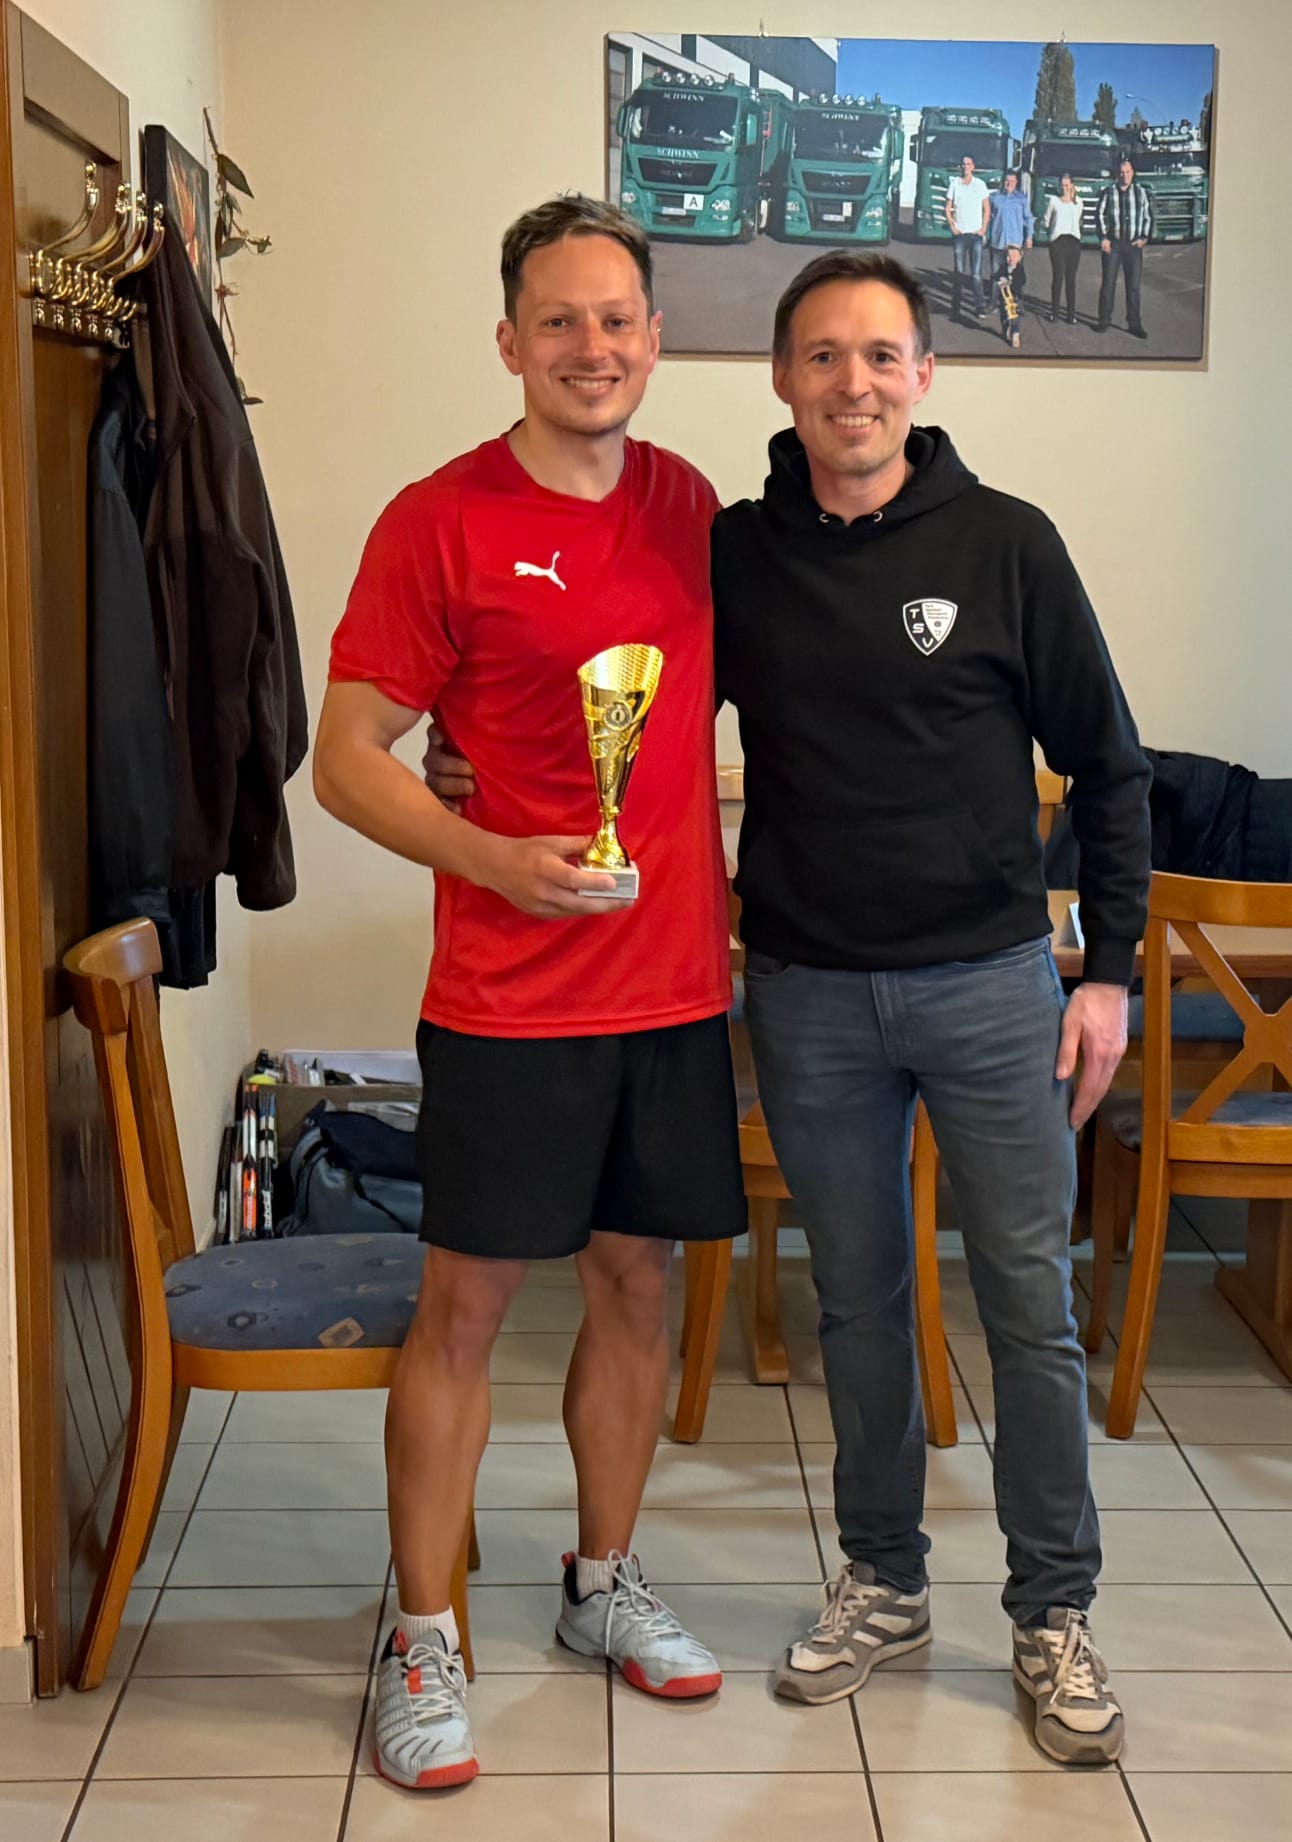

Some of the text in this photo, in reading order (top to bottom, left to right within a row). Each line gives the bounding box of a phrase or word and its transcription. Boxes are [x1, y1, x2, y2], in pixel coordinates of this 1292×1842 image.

[663, 92, 705, 102] SCHWINN
[656, 147, 700, 159] SCHWINN
[688, 195, 698, 207] A
